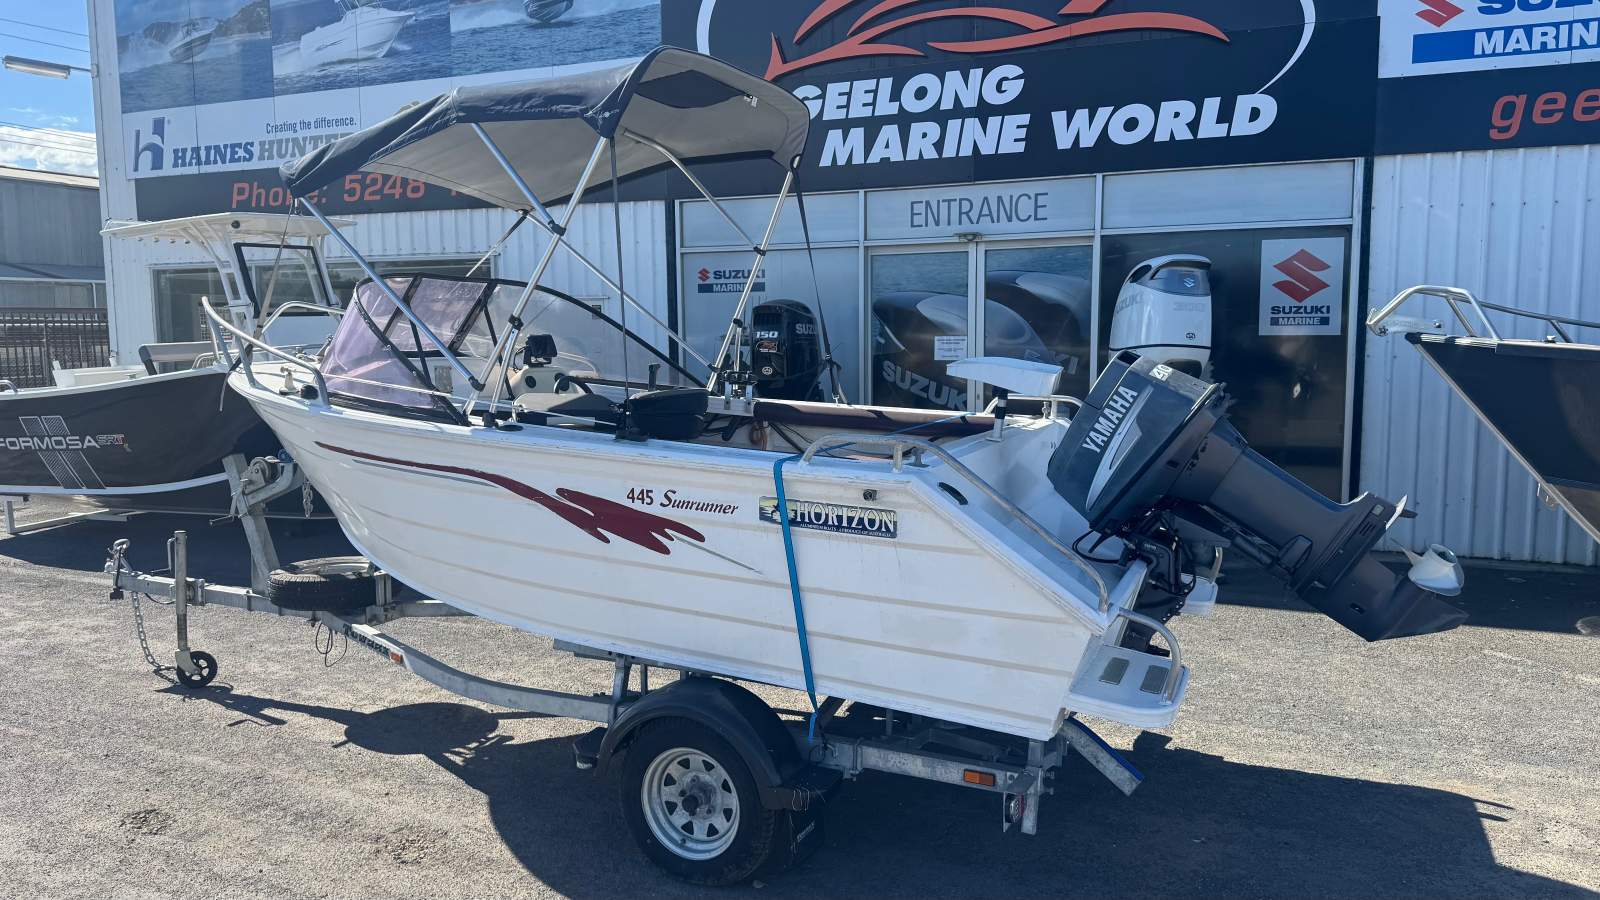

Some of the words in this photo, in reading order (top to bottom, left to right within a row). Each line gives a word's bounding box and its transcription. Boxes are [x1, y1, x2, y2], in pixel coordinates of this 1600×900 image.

[791, 64, 1025, 120] GEELONG
[266, 122, 297, 134] Creating
[299, 120, 312, 131] the
[313, 116, 357, 129] difference.
[819, 113, 1031, 167] MARINE
[1051, 93, 1278, 150] WORLD
[172, 141, 255, 168] HAINES
[343, 172, 426, 202] 5248
[910, 192, 1049, 228] ENTRANCE
[1270, 305, 1331, 315] SUZUKI
[1279, 317, 1321, 325] MARINE
[755, 331, 779, 339] 150
[1082, 385, 1139, 453] YAMAHA
[626, 487, 654, 506] 445
[660, 489, 739, 515] Sunrunner
[796, 502, 895, 532] HORIZON
